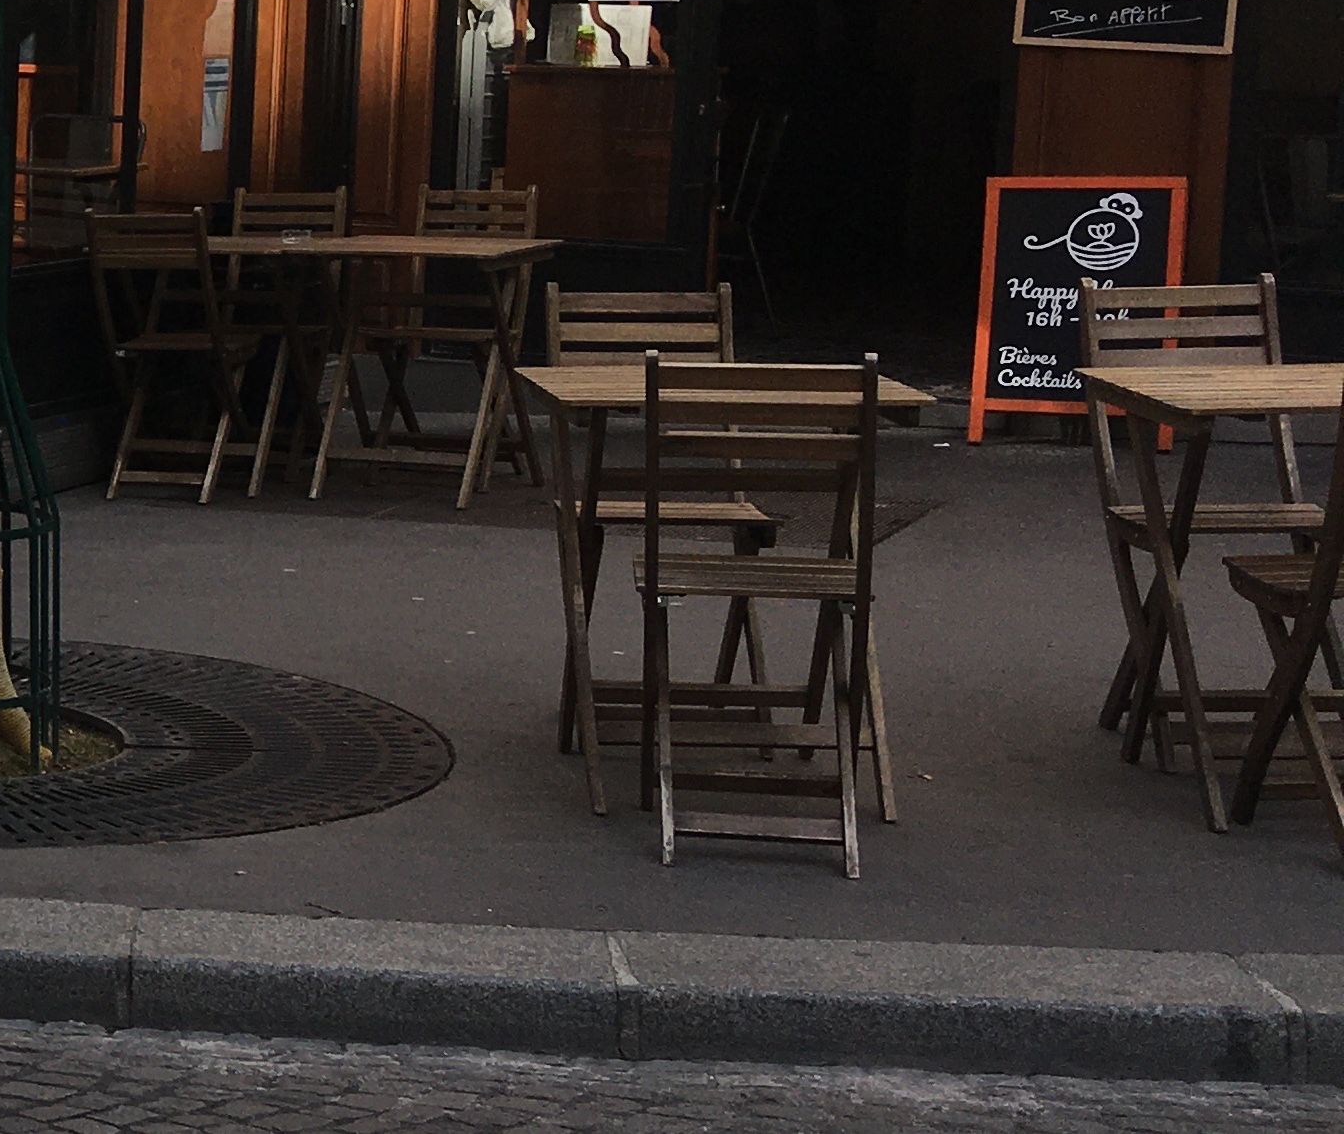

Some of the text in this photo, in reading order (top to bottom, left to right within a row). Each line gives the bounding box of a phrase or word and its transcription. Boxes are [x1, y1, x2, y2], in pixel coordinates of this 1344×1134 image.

[1007, 278, 1079, 310] Happy
[1026, 305, 1063, 326] 16h
[998, 346, 1057, 365] Bières
[997, 368, 1082, 390] Cocktails
